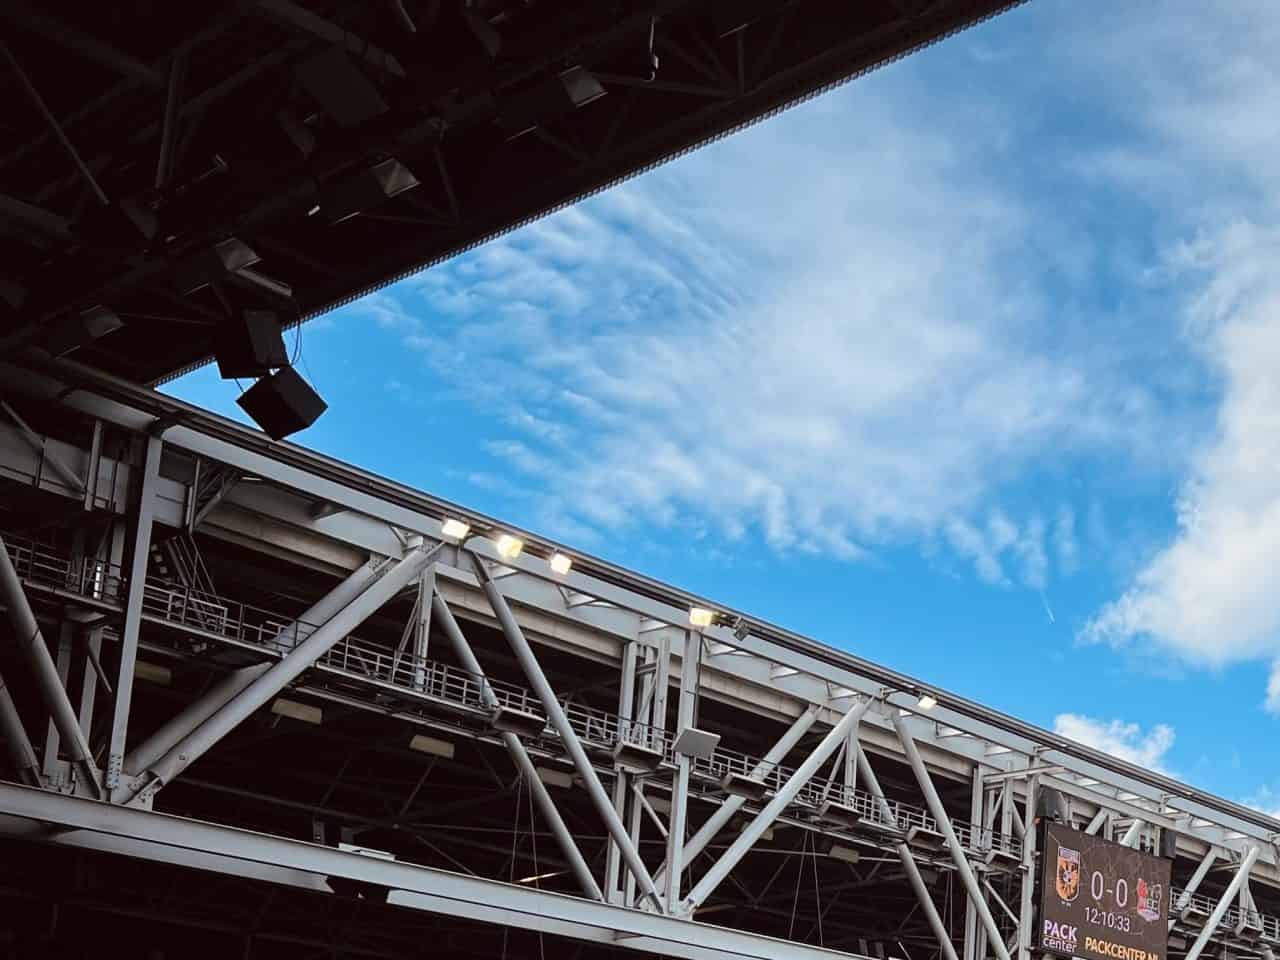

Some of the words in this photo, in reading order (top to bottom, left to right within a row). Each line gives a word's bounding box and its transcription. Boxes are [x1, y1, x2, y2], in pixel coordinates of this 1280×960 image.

[1043, 919, 1078, 942] PACK
[1084, 907, 1130, 932] 12:10:33
[1042, 936, 1078, 953] center
